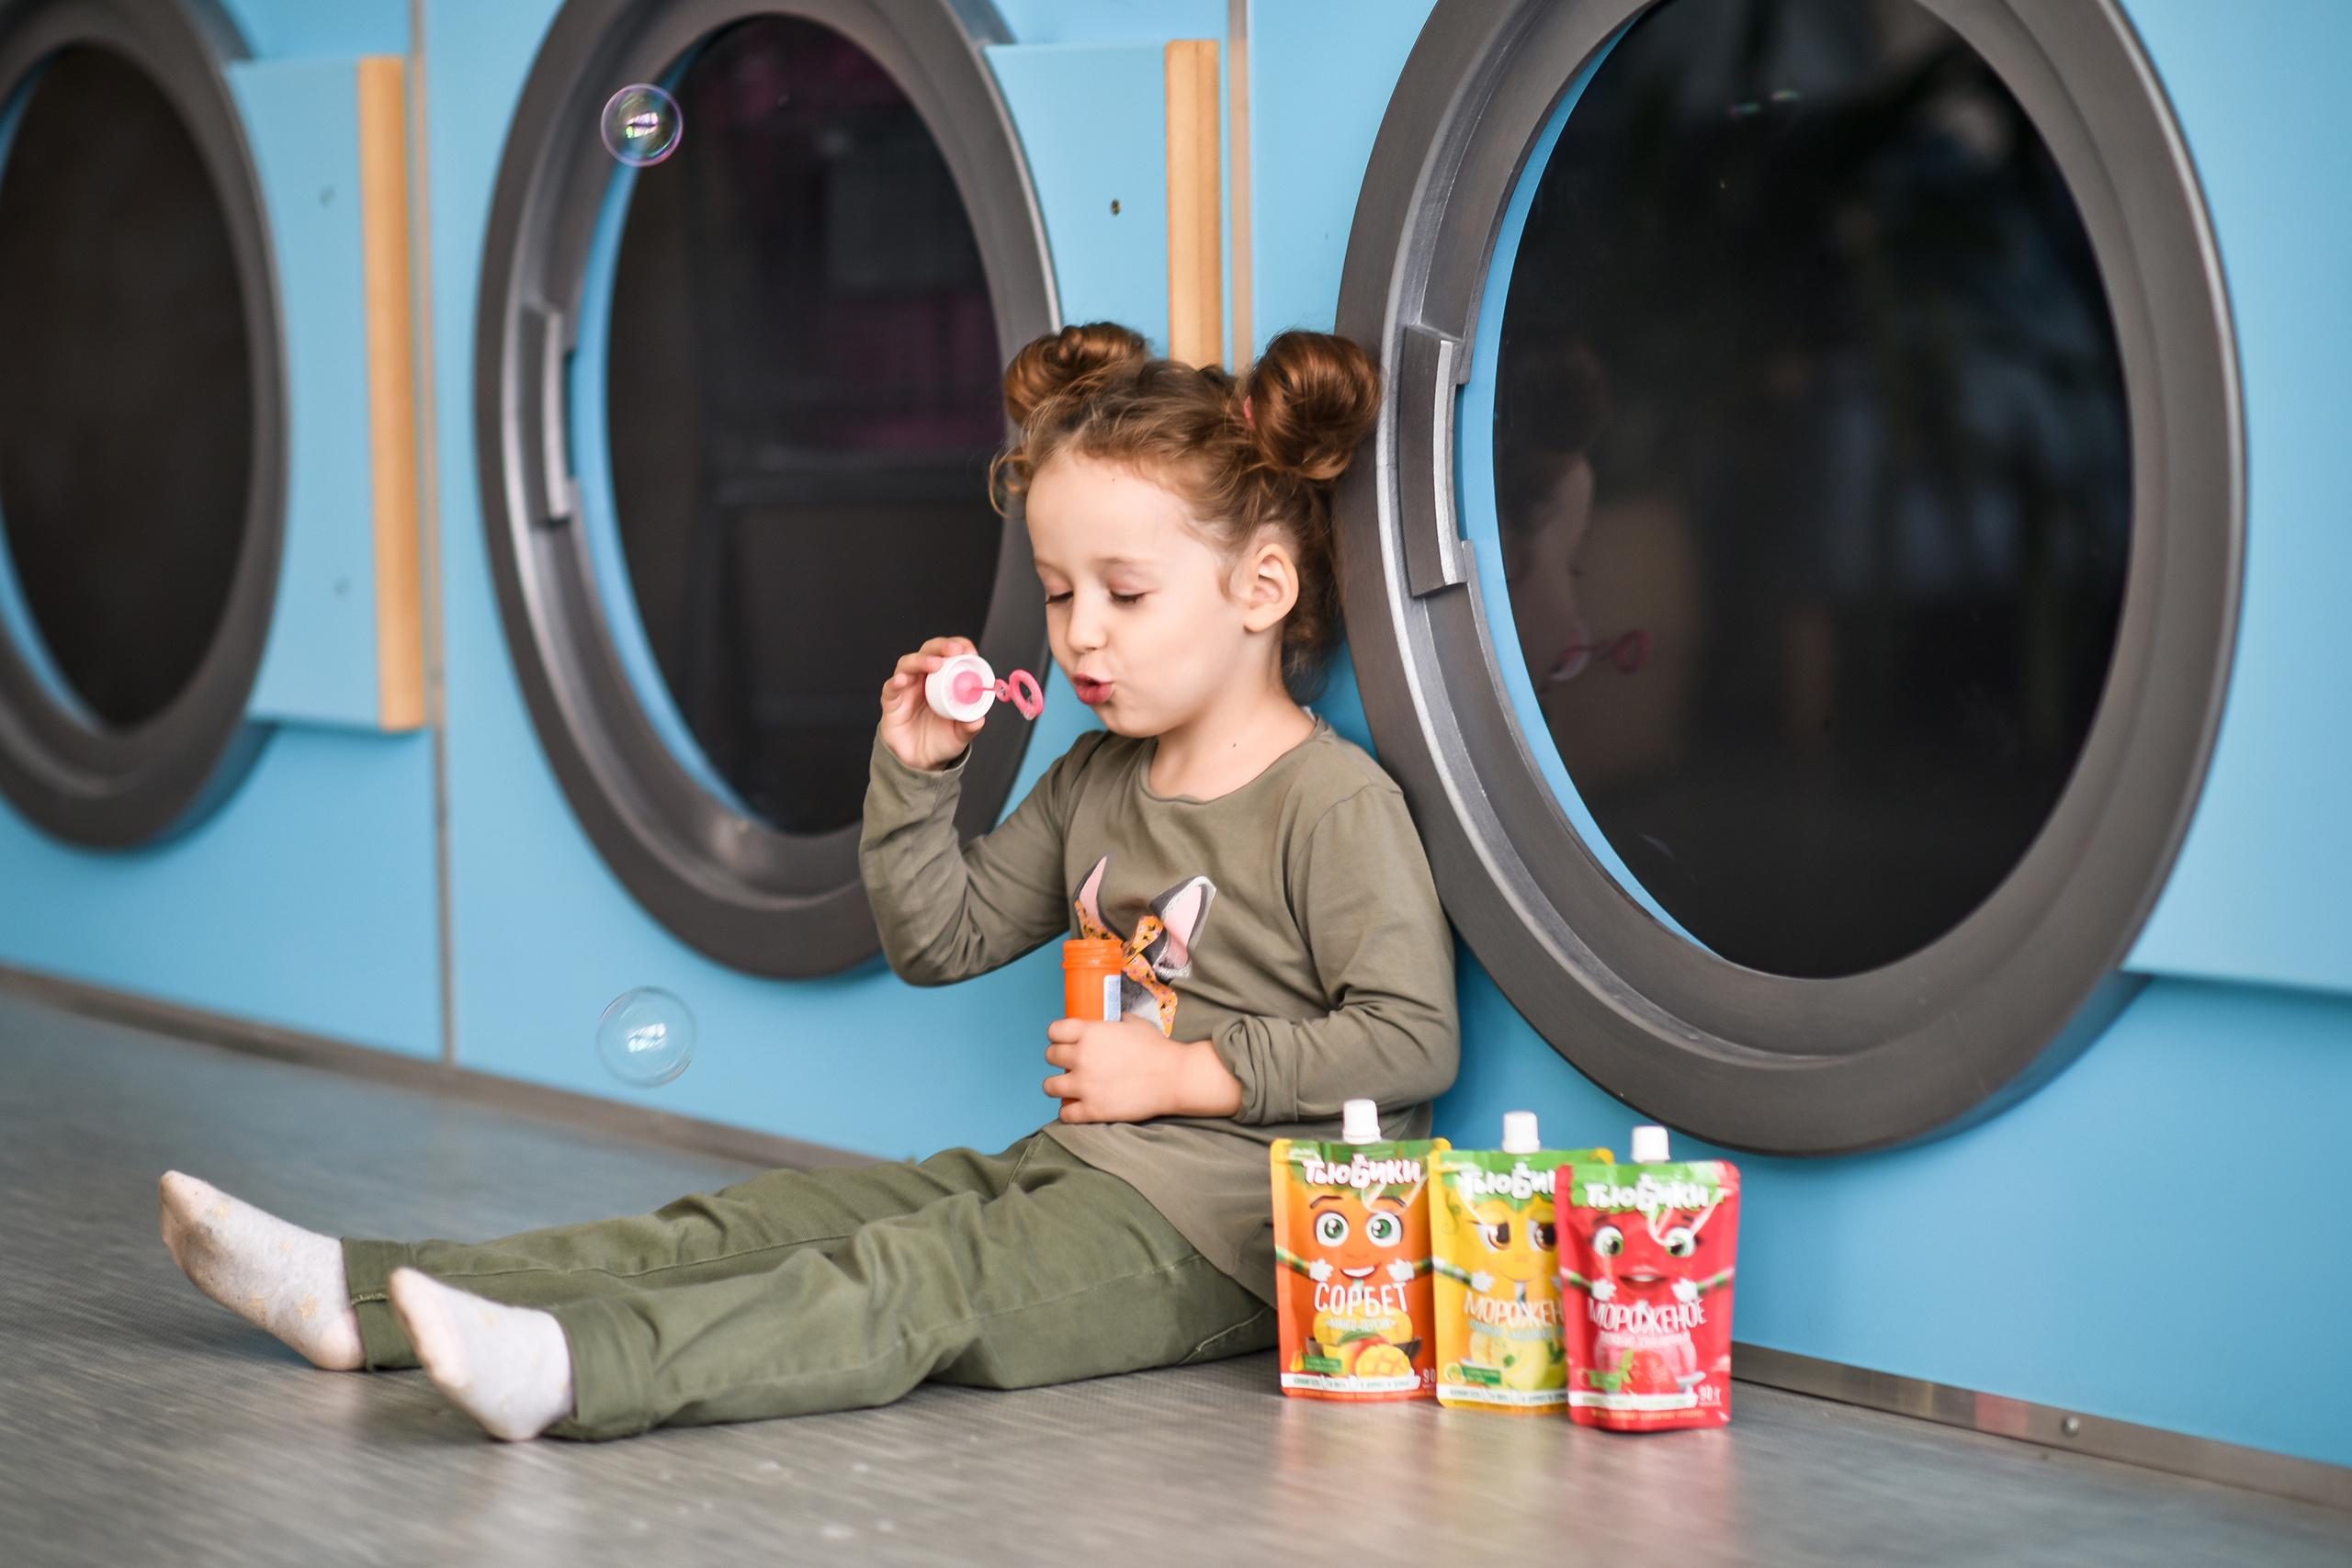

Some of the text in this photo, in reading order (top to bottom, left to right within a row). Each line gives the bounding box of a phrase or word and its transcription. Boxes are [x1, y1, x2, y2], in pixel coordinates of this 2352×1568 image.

[1314, 1282, 1408, 1317] СОРБЕТ
[1588, 1297, 1708, 1335] МОРОЖЕНОЕ
[1422, 1368, 1436, 1383] 90
[1700, 1384, 1713, 1402] 90
